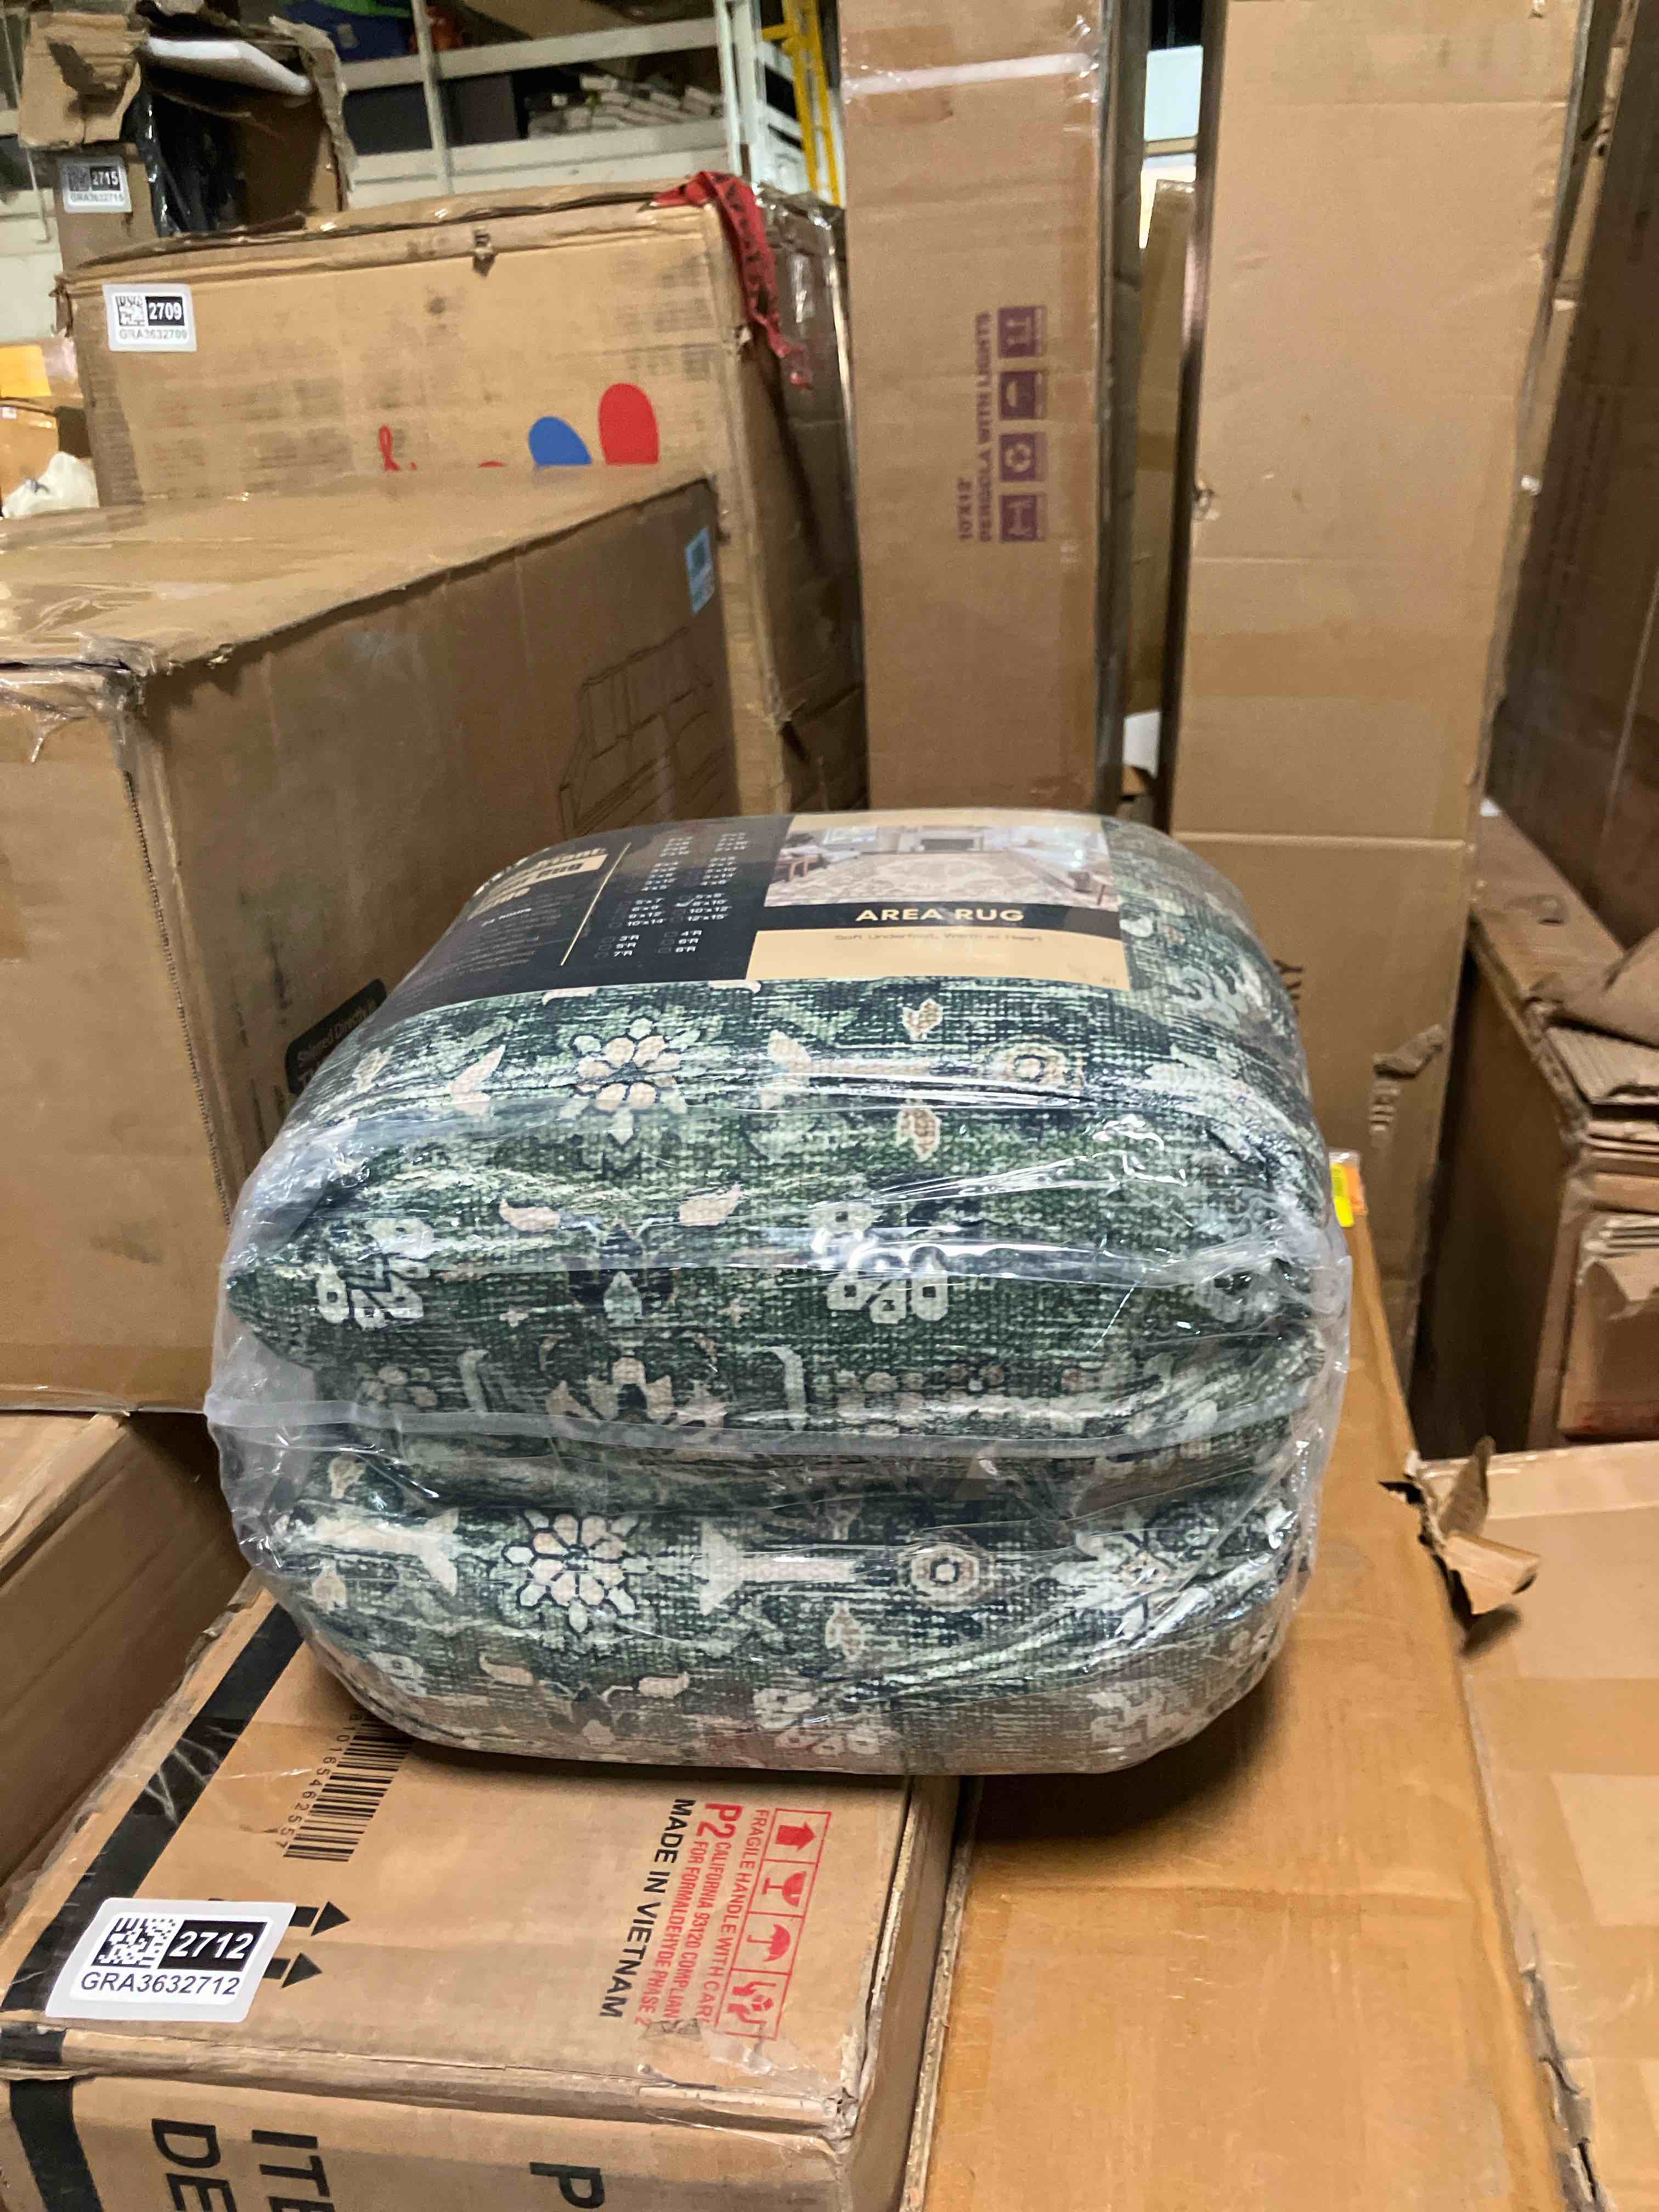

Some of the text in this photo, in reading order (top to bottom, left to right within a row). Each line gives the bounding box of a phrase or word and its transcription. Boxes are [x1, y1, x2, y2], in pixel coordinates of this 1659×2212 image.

[92, 171, 119, 185] 2715
[148, 302, 182, 320] 2709
[975, 311, 992, 388] LIGHTS
[976, 392, 991, 444] WITH
[855, 909, 1025, 922] AREA RUG
[696, 1803, 744, 1839] P2
[739, 1808, 770, 1870] FRAGILE
[599, 1799, 697, 2018] MADE IN VIETNAM
[721, 1872, 753, 1934] HANDLE
[169, 1931, 254, 1960] 2712
[634, 1841, 709, 2027] FOR FORMALDEHYDE PHASE 2
[662, 1841, 732, 2019] CALIFORNIA 93120 COMPLIAN
[707, 1937, 733, 1977] WITH
[81, 1971, 240, 1995] GRA3632712
